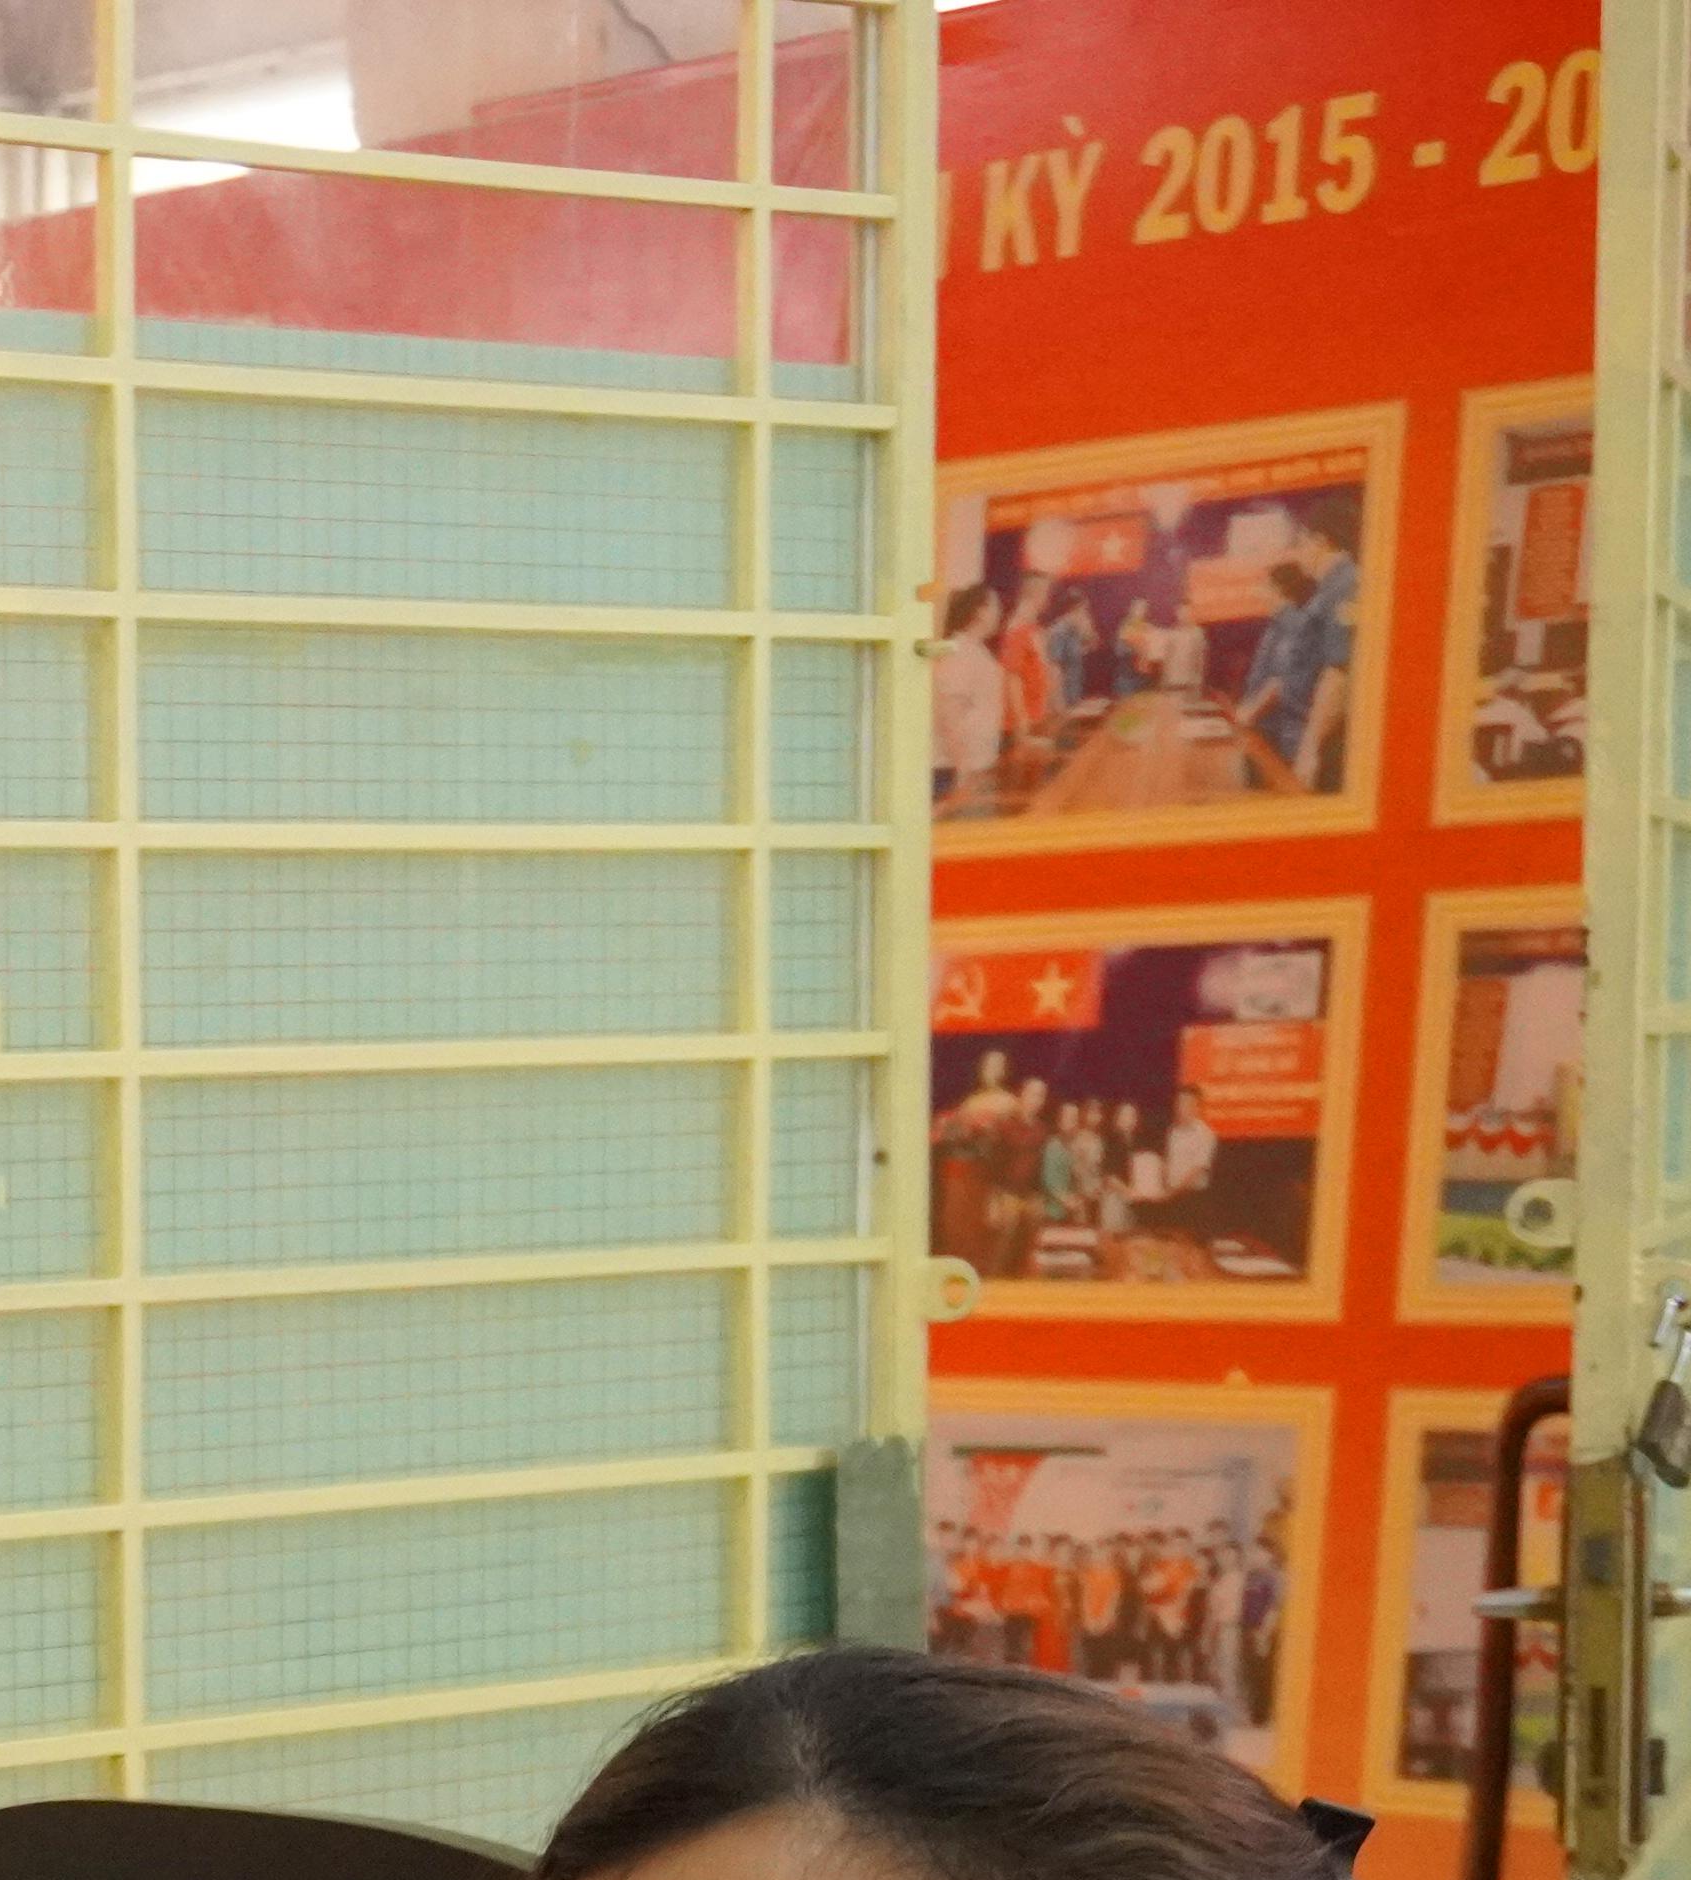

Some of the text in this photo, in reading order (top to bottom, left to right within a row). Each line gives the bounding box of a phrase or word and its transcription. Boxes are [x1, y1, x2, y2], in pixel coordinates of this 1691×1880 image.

[980, 115, 1105, 272] KỲ
[1132, 92, 1379, 246] 2015
[1412, 140, 1447, 168] -
